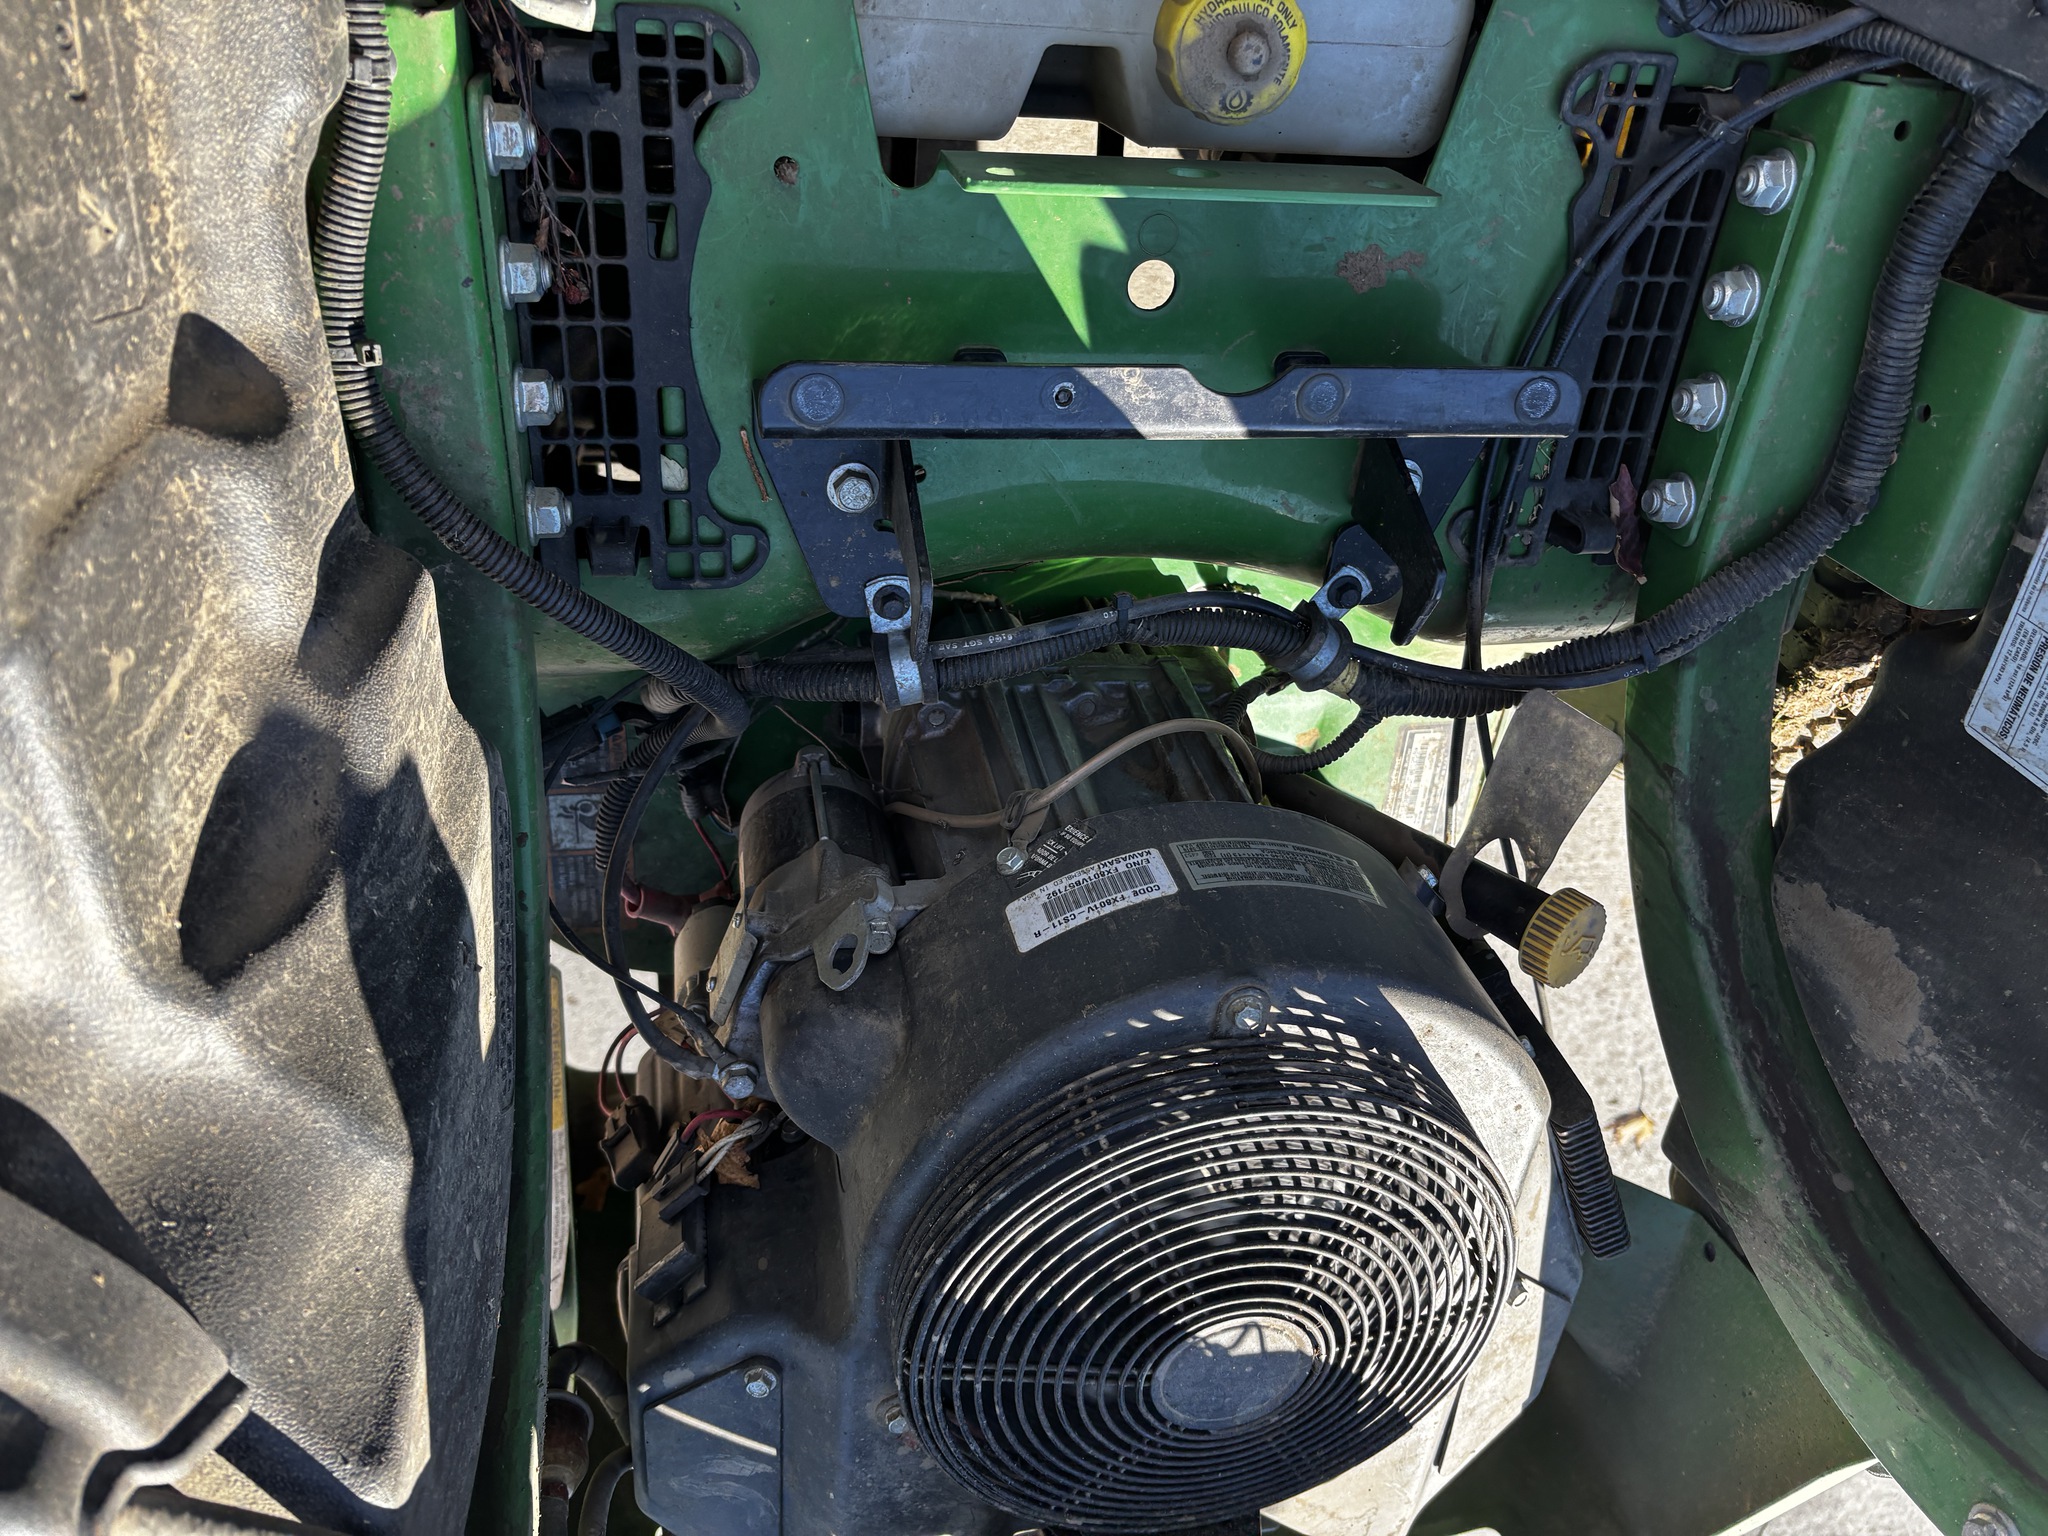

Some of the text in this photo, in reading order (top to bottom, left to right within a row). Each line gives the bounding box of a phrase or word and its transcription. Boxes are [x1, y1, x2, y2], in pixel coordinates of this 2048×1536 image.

[1277, 3, 1297, 28] ONLY
[961, 637, 982, 648] SGT
[2010, 620, 2025, 649] TRASEROS:
[938, 640, 957, 651] SAE
[2021, 628, 2037, 663] DELANTEROS:
[1998, 635, 2048, 740] PRESIÓN DE NEUMÁTICOS:
[1096, 849, 1151, 869] KAWASAKI
[1045, 857, 1150, 899] E/NO FX801VB57192
[1053, 868, 1091, 886] ASSEMBLED
[1021, 891, 1035, 902] USA
[1132, 884, 1160, 896] CODE
